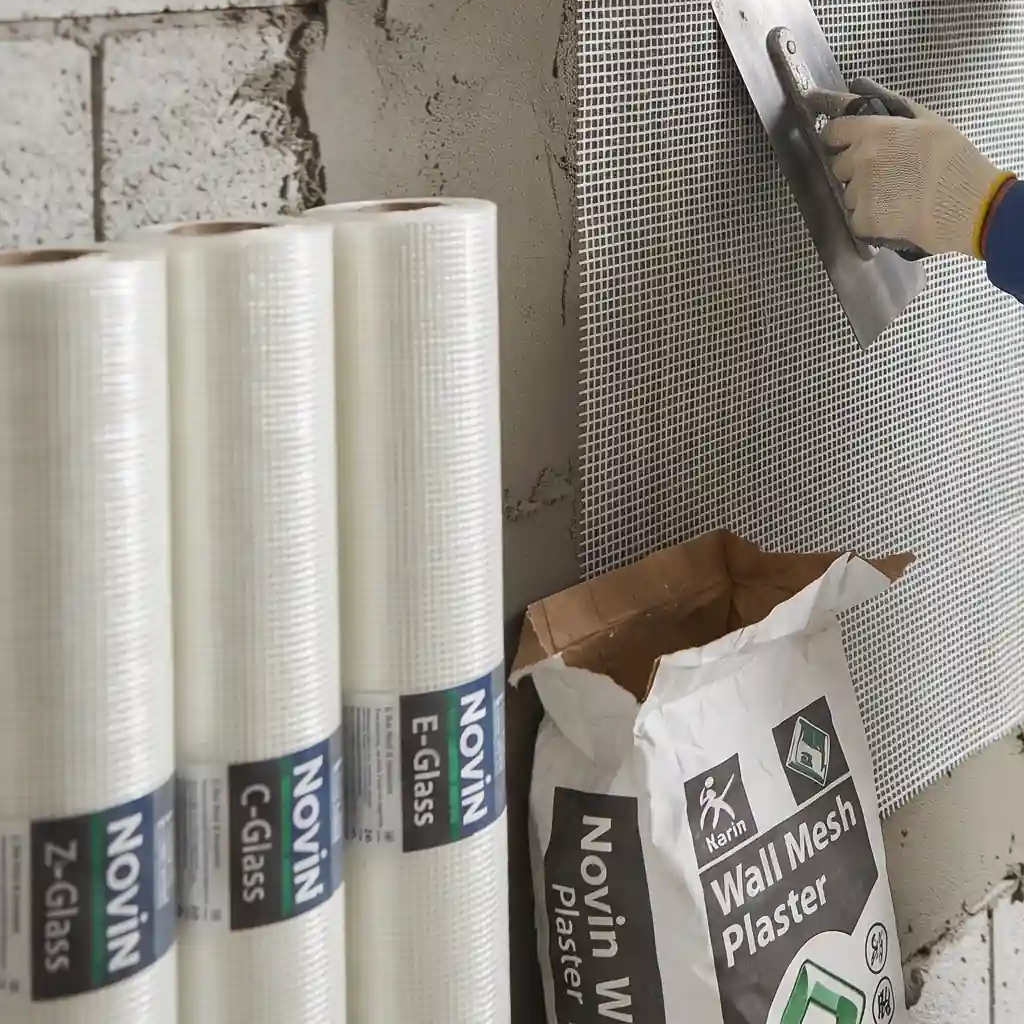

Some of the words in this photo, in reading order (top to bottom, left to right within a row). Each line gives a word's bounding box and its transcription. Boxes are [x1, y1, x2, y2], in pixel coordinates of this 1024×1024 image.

[412, 714, 440, 827] E-Glass
[240, 783, 272, 903] C-Glass
[580, 814, 626, 958] Novin
[710, 842, 783, 916] Wall
[783, 794, 857, 871] Mesh
[44, 839, 79, 974] Z-Glass
[551, 883, 584, 1005] Plaster
[722, 874, 827, 968] Plaster
